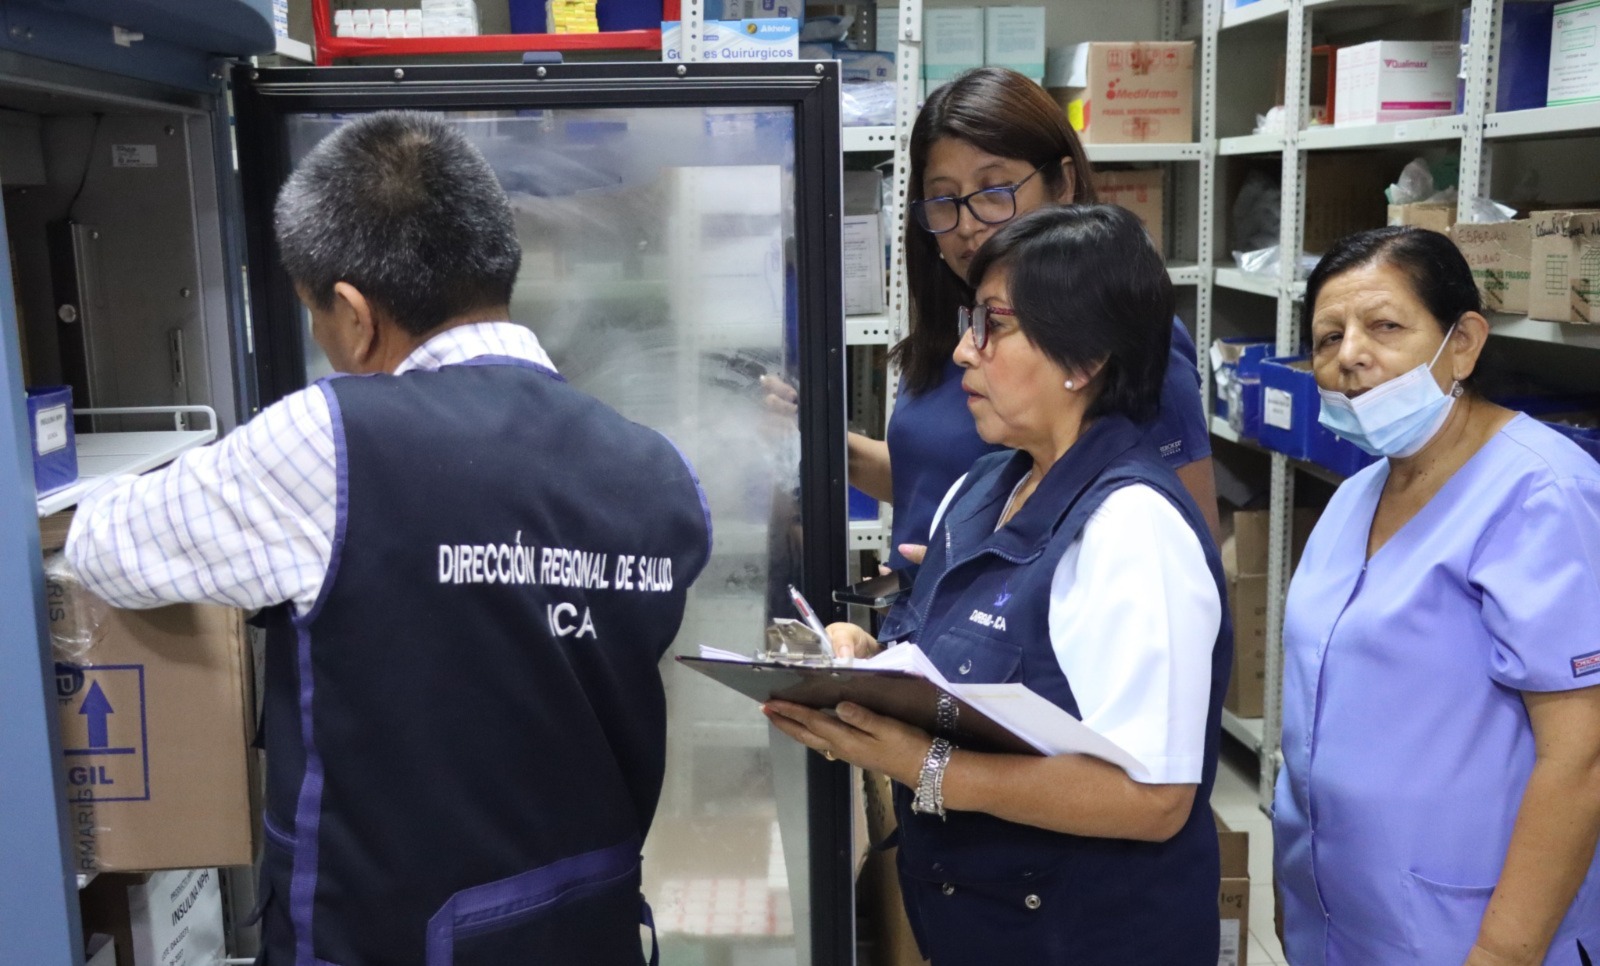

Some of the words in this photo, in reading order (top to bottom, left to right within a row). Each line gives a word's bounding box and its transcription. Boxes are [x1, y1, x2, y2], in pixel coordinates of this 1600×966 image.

[721, 47, 794, 60] Quirúrgicos
[439, 530, 536, 584] DIRECCIÓN
[541, 547, 609, 589] REGIONAL
[615, 554, 635, 590] DE
[638, 555, 673, 592] SALUD
[547, 602, 597, 639] ICA
[69, 766, 114, 785] GIL
[171, 885, 198, 927] INSULINA
